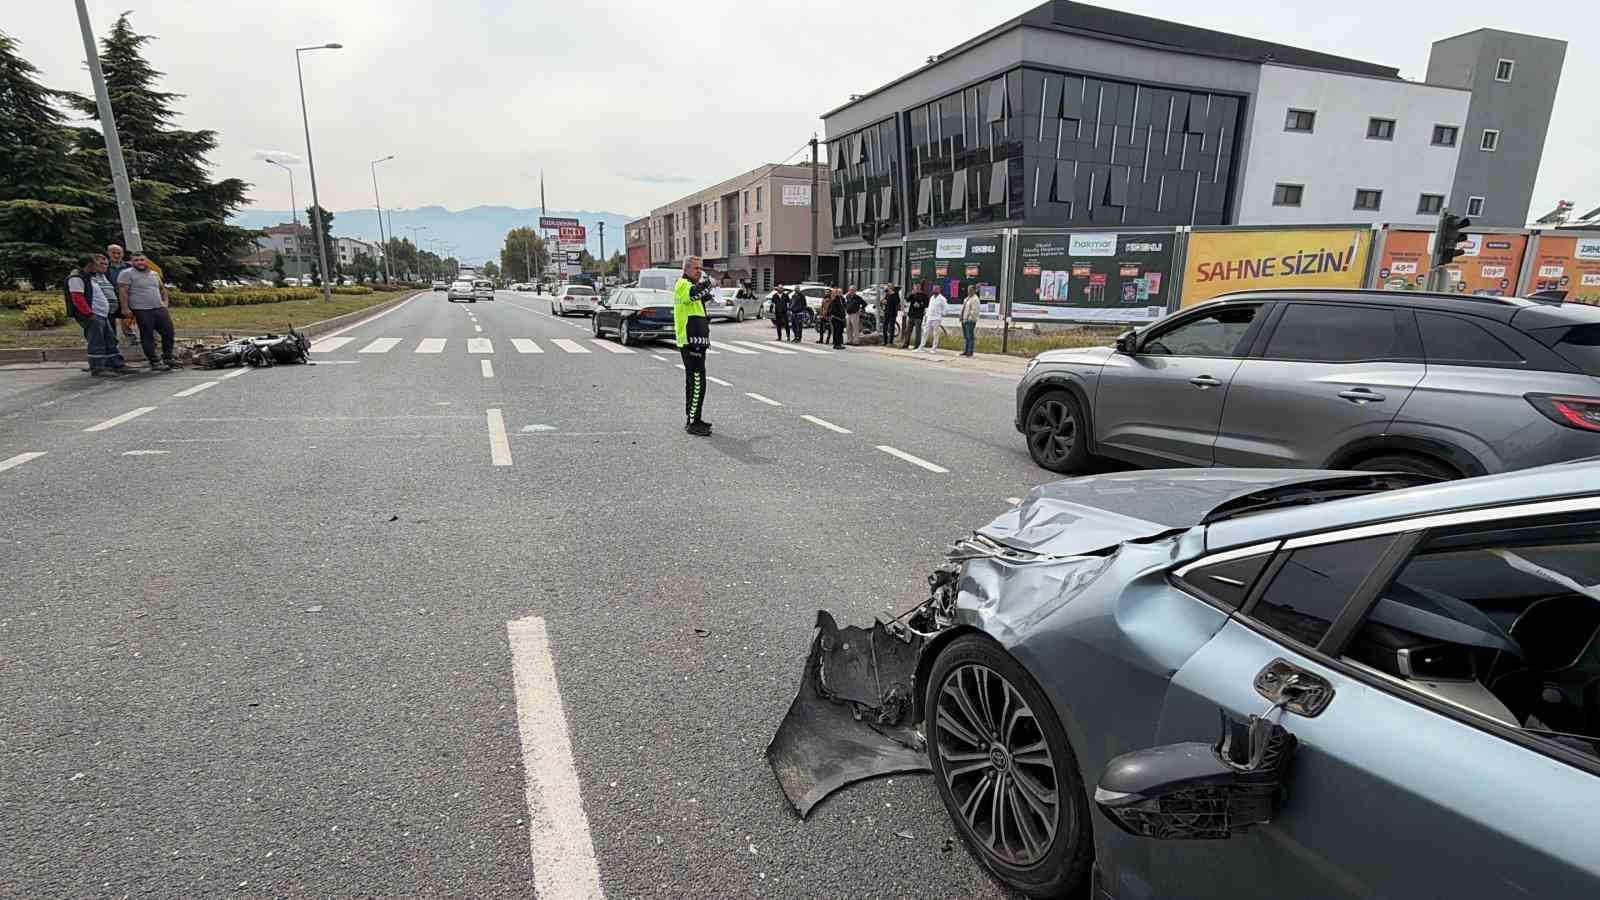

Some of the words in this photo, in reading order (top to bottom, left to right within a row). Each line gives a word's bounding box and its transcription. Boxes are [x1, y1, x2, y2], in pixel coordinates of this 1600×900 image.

[1073, 240, 1112, 249] hakmar
[1196, 257, 1276, 283] SAHNE
[1280, 245, 1355, 276] SİZİN!
